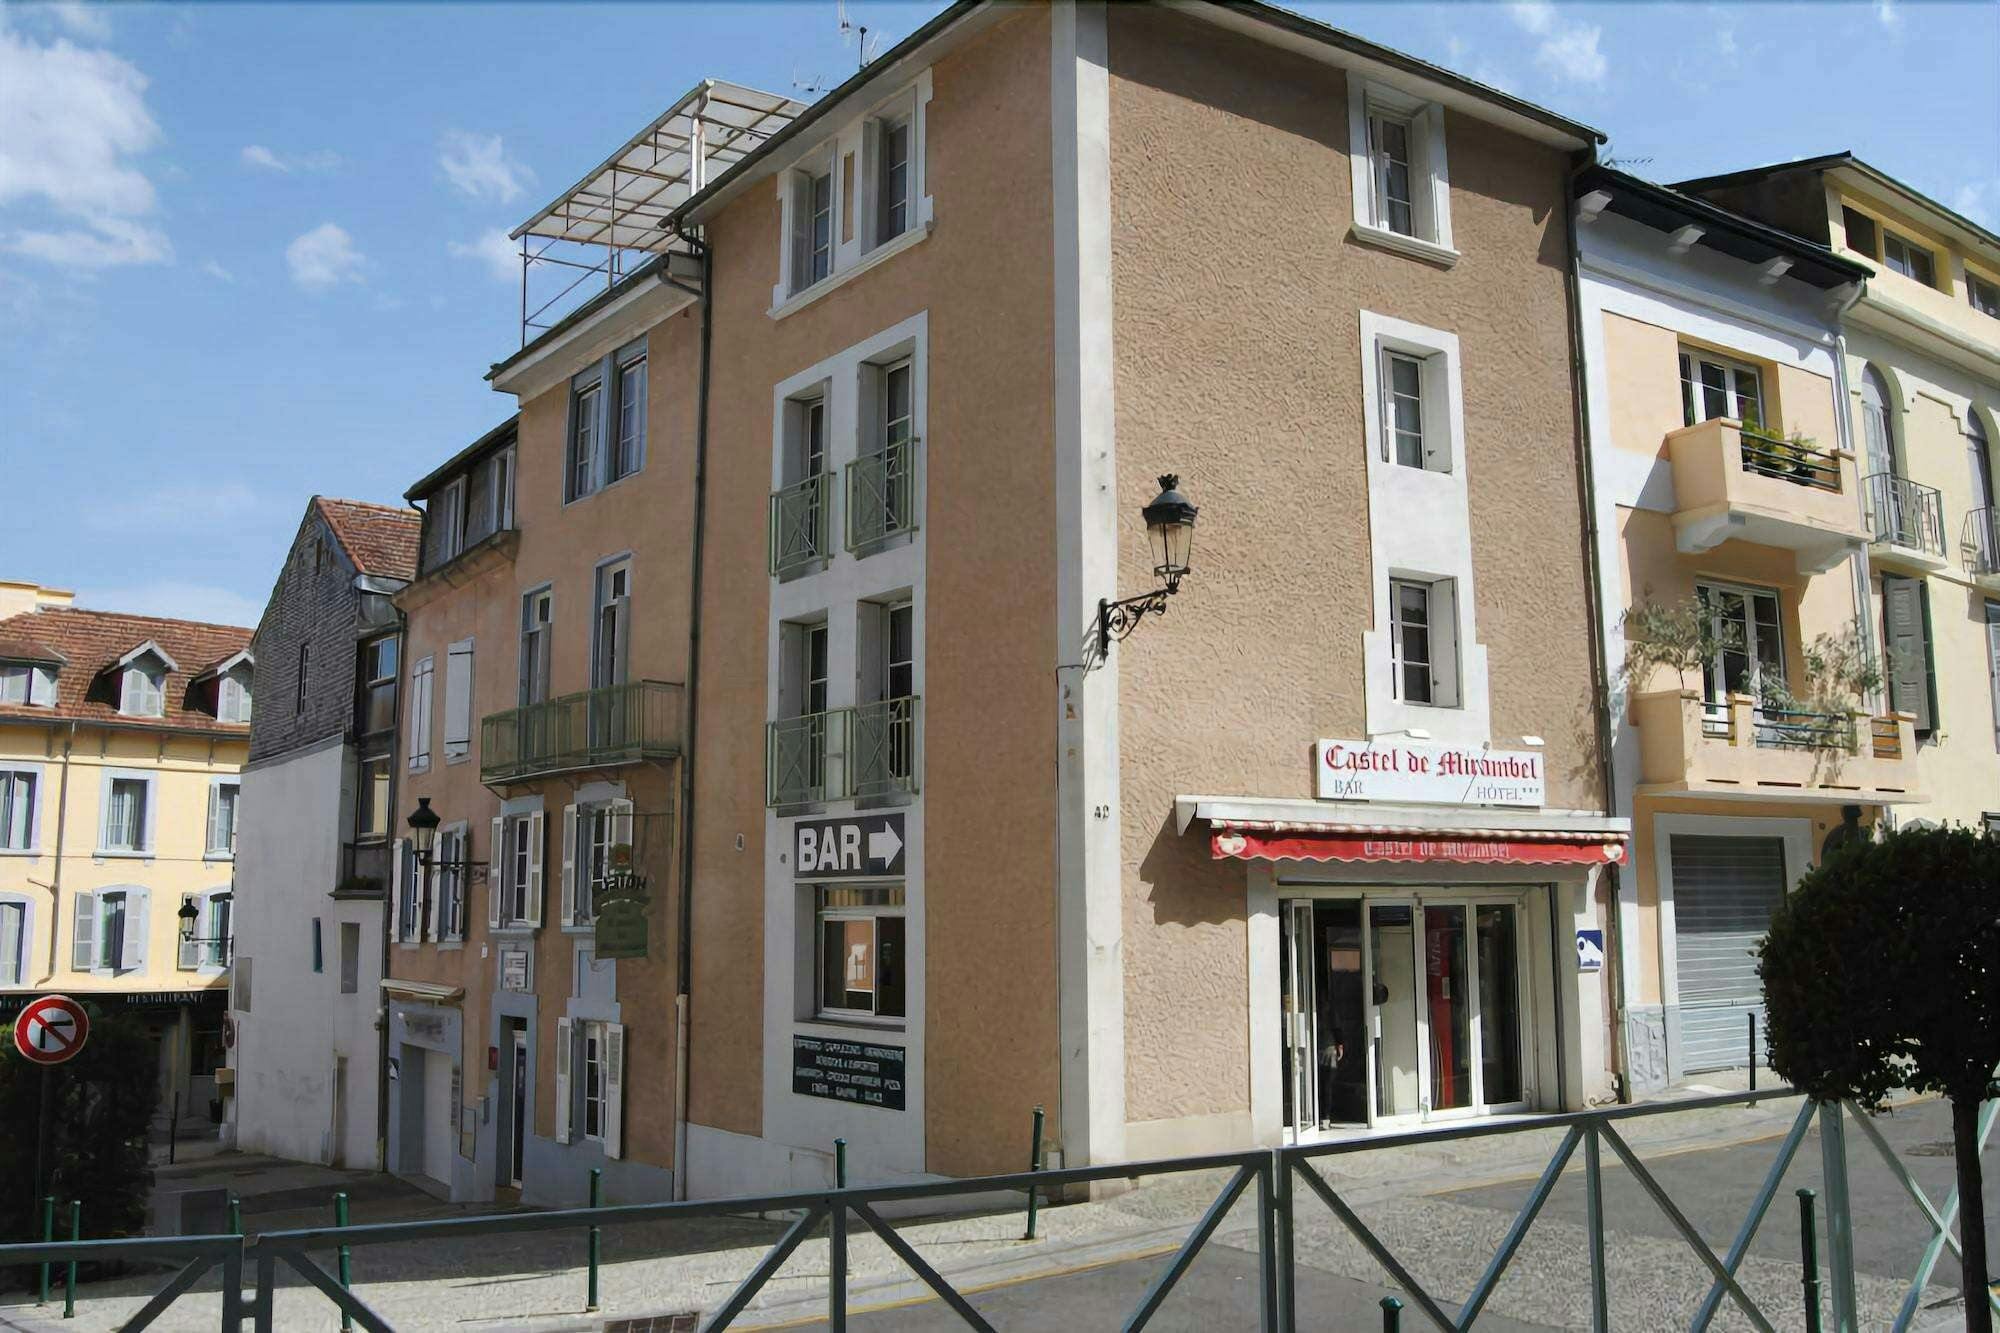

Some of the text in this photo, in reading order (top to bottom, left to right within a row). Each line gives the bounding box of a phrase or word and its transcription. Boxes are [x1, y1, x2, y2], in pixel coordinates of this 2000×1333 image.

[1325, 744, 1538, 779] Castel de Mirambel
[1334, 779, 1363, 794] BAR
[798, 825, 862, 873] BAR
